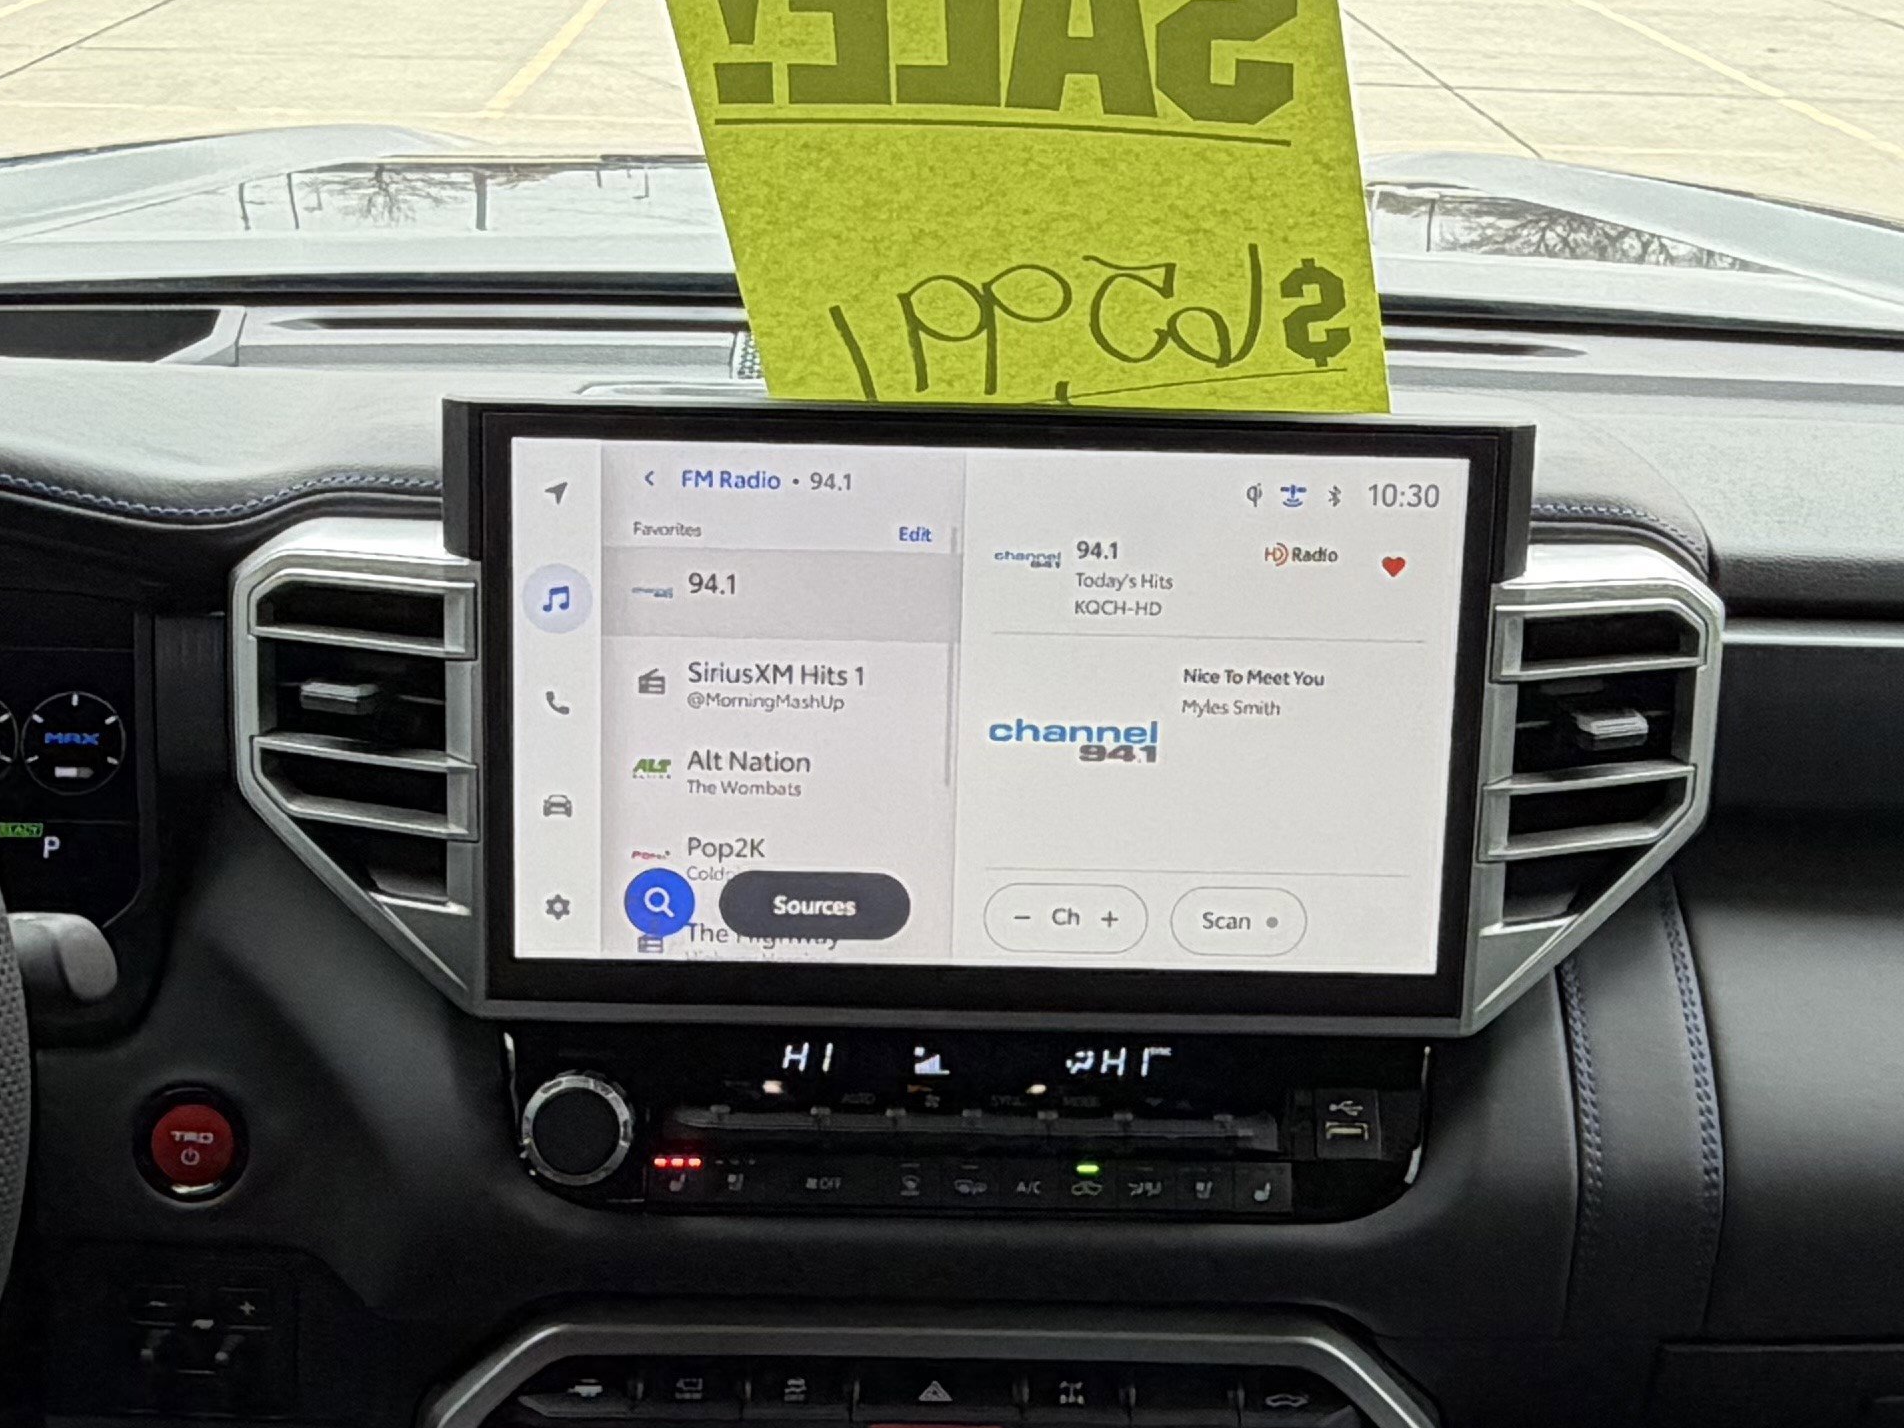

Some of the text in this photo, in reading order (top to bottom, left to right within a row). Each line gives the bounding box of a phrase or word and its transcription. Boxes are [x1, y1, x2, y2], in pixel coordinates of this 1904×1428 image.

[681, 469, 853, 491] FM Radio 94.1
[1367, 483, 1441, 508] 10:30
[632, 520, 702, 539] Favorites
[898, 525, 933, 543] Edit
[1076, 540, 1119, 560] 94.1
[1291, 546, 1339, 565] Radio
[687, 571, 737, 596] 94.1
[1076, 572, 1174, 591] Today's Hits
[687, 661, 865, 687] SiriusXM Hits 1
[1182, 667, 1326, 688] Nice To Meet You
[686, 691, 845, 713] @MorningMashUp
[1181, 699, 1282, 718] Myles Smith
[44, 731, 100, 746] MAX
[988, 718, 1159, 745] channel
[686, 749, 812, 774] Alt Nation
[1078, 744, 1158, 764] 94.1
[632, 758, 672, 774] ALT
[686, 779, 802, 797] The Wombats
[42, 835, 61, 860] P
[687, 836, 766, 863] Pop2K
[773, 894, 857, 917] Sources
[1051, 907, 1081, 927] Ch
[1201, 911, 1252, 931] Scan
[688, 922, 729, 944] The
[170, 1130, 214, 1144] TRD
[1016, 1180, 1041, 1195] A/C
